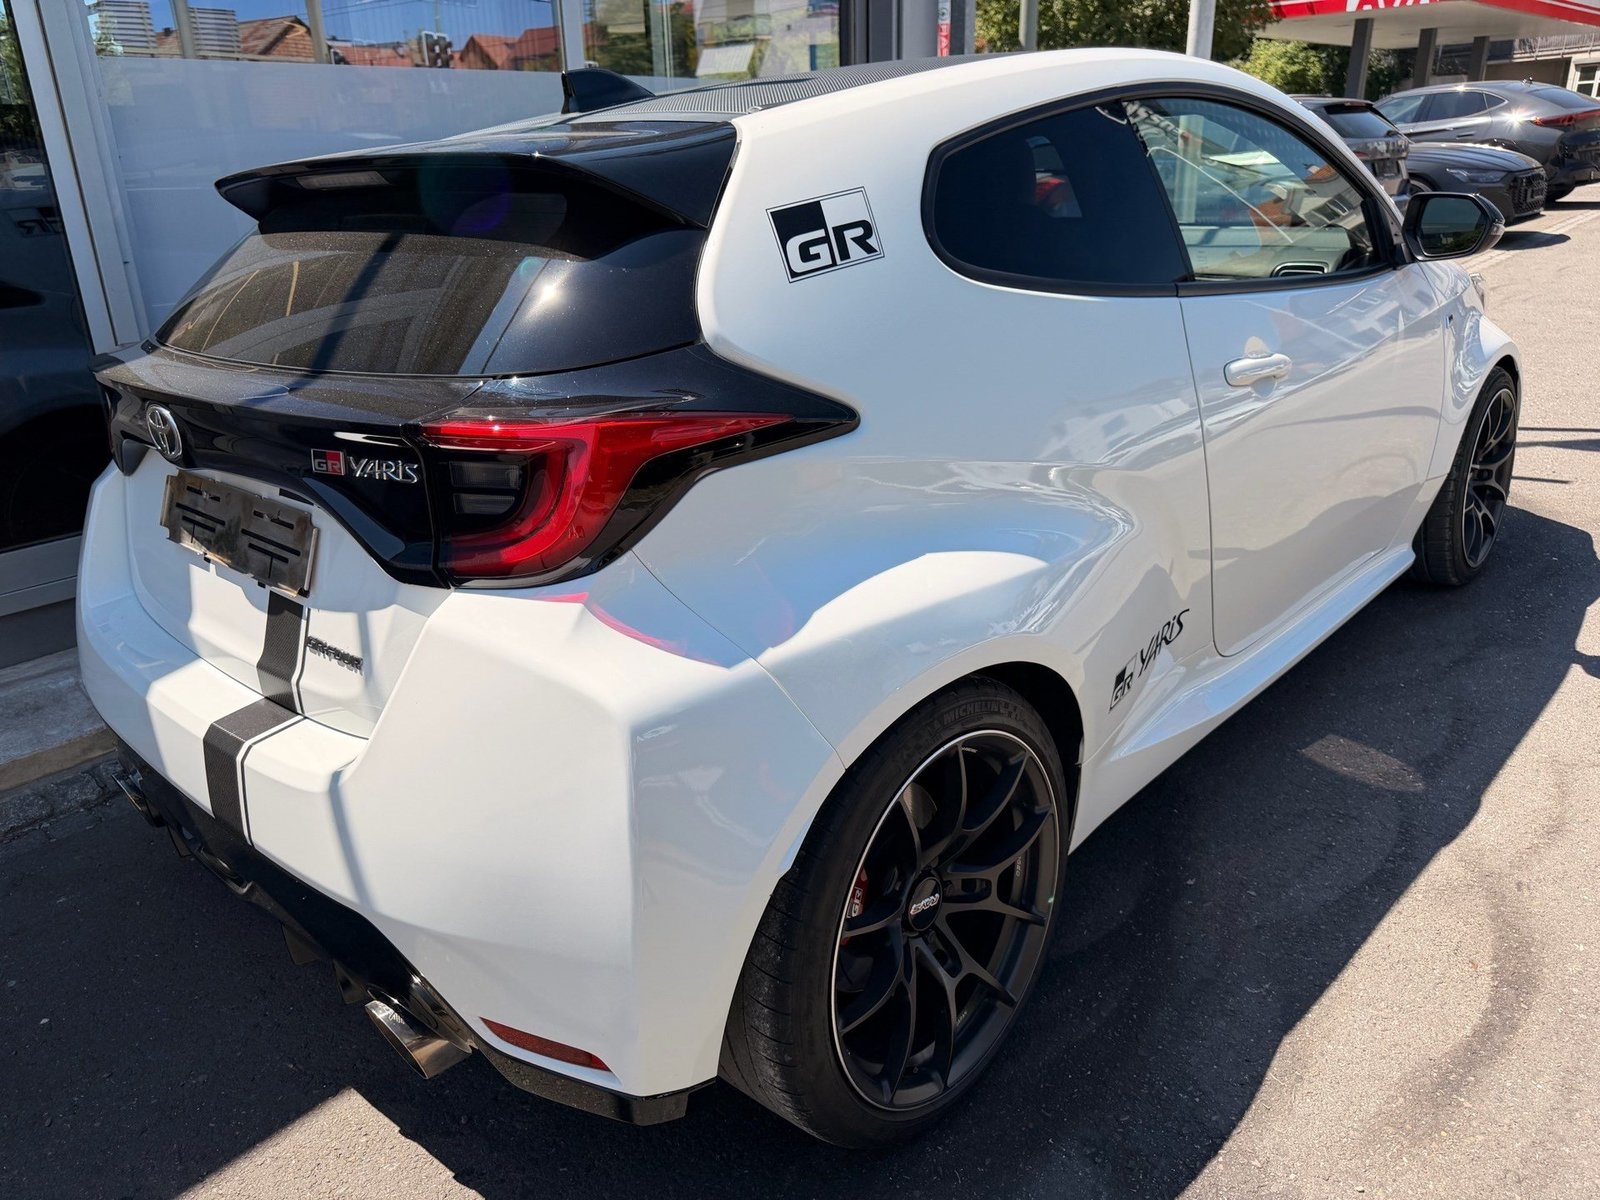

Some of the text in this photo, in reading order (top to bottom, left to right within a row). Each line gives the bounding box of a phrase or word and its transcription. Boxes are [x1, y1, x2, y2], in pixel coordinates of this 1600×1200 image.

[786, 220, 879, 273] GR
[314, 458, 341, 473] GR
[943, 701, 1000, 725] MICHELIN
